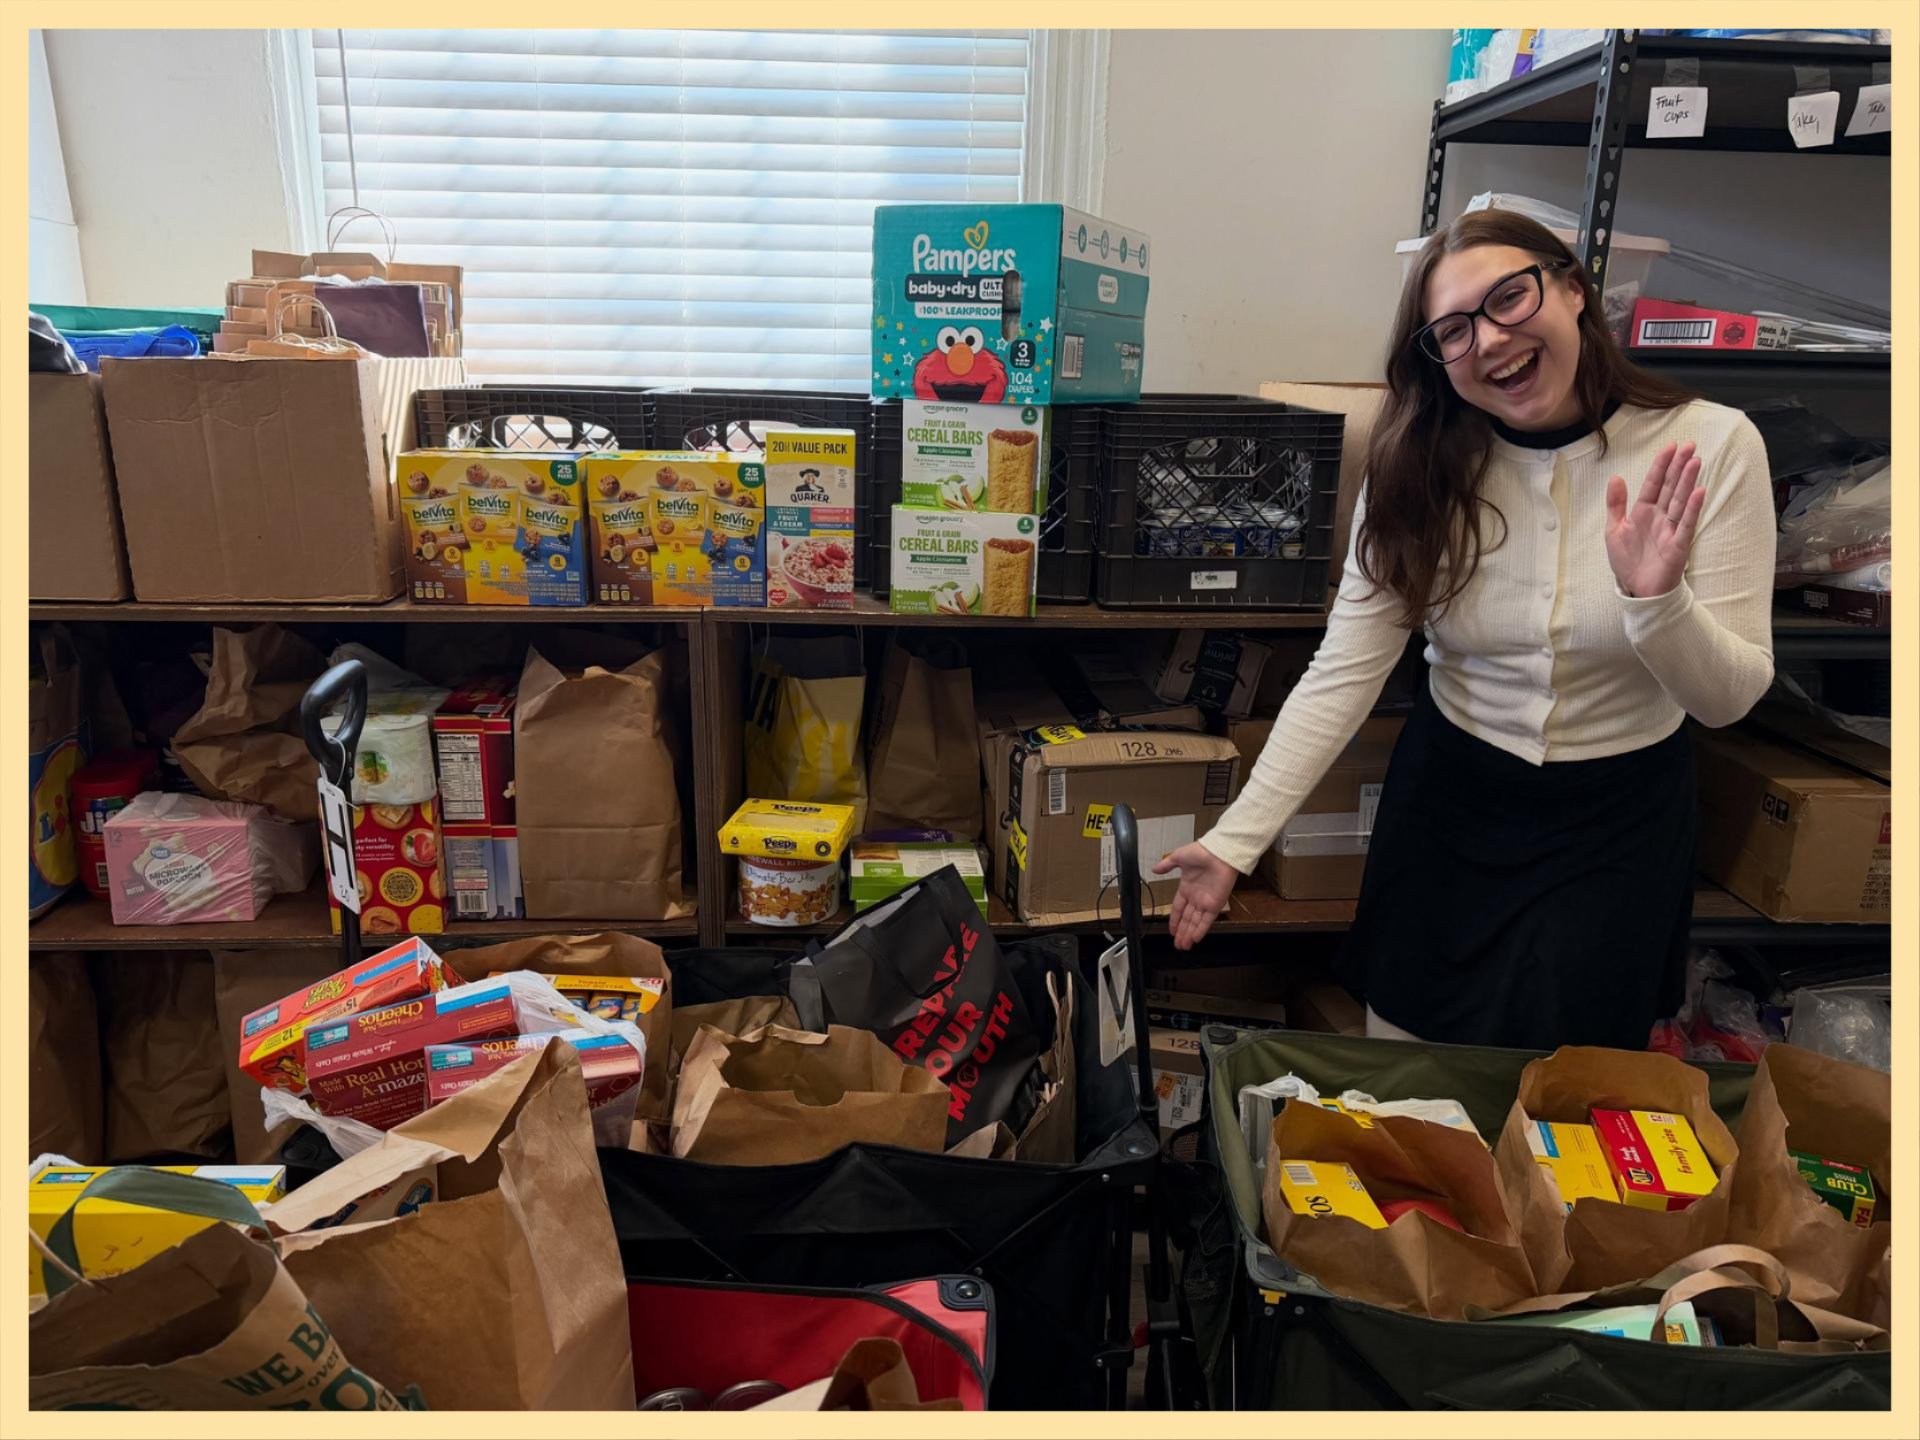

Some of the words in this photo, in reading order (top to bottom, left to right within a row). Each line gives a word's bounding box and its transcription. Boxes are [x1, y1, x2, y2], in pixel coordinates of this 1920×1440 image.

[1656, 93, 1684, 109] Fruit
[1664, 110, 1689, 124] cups
[912, 234, 1016, 277] Pampers
[1017, 342, 1028, 358] 3
[1010, 372, 1032, 384] 104
[1008, 385, 1034, 393] DIAPERS
[946, 406, 968, 414] grocery
[924, 419, 941, 428] FRUIT
[948, 420, 966, 428] GRAIN
[907, 428, 950, 443] CEREAL
[952, 430, 983, 445] BARS
[772, 441, 785, 453] 20
[791, 442, 820, 454] VALUE
[823, 443, 847, 454] PACK
[557, 464, 572, 474] 25
[744, 468, 759, 477] 25
[468, 495, 510, 509] belVita
[657, 497, 699, 511] belVita
[790, 492, 829, 504] QUAKER
[413, 503, 455, 519] belVita
[526, 507, 568, 525] belVita
[603, 507, 644, 523] belVita
[713, 510, 754, 527] belVita
[918, 529, 935, 537] FRUIT
[942, 530, 961, 538] GRAIN
[900, 537, 944, 552] CEREAL
[947, 539, 978, 553] BARS
[1121, 742, 1157, 758] 128
[773, 803, 822, 814] Peeps
[762, 837, 798, 850] Peeps
[358, 1001, 423, 1026] Cheerios
[925, 1001, 983, 1077] OUR
[1168, 1037, 1200, 1051] 128
[346, 1066, 386, 1088] Real
[1662, 1128, 1678, 1144] size
[1668, 1146, 1693, 1174] family
[1826, 1177, 1867, 1195] CLUB
[220, 1352, 304, 1396] WE
[308, 1346, 341, 1388] over
